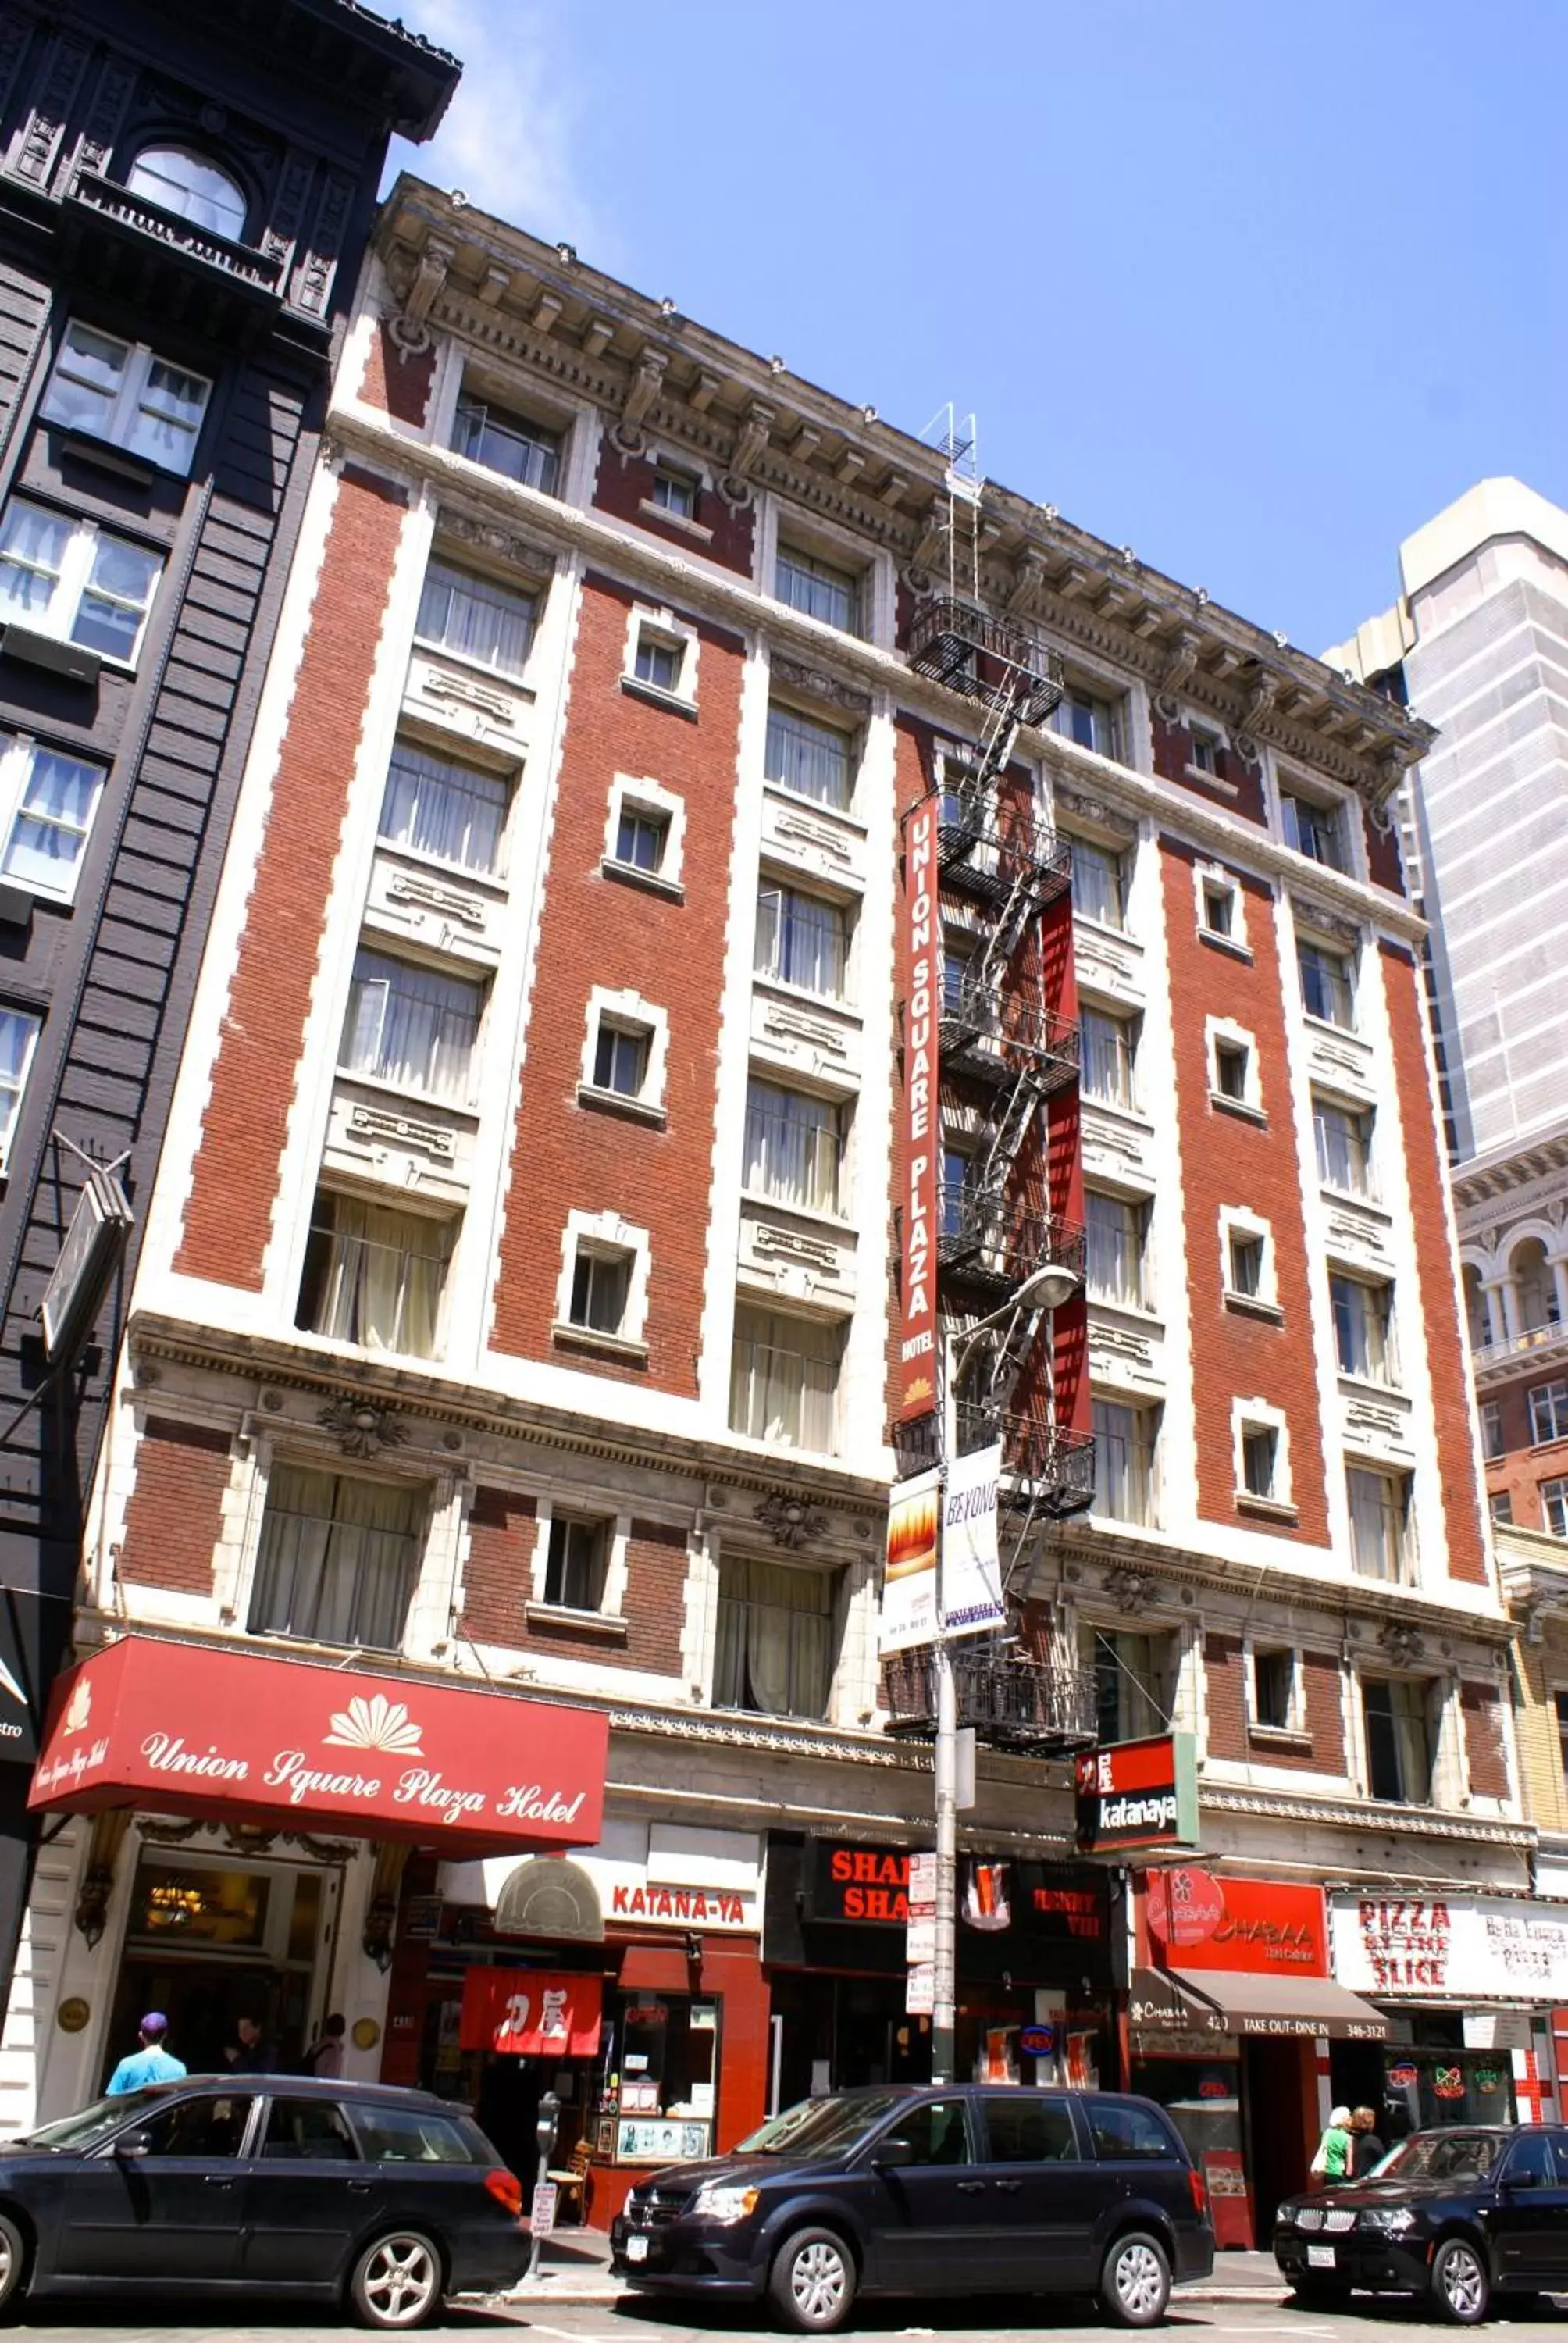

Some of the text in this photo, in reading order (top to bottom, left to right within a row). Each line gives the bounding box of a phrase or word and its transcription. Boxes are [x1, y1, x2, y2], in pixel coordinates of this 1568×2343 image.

[907, 813, 931, 1320] UNION SQUARE PLAZA
[902, 1330, 934, 1362] HOTEL
[141, 1732, 586, 1824] Union Square Plaza Hotel
[1099, 1796, 1177, 1828] katanaya
[613, 1886, 745, 1923] KATANA-YA
[1359, 1900, 1450, 1928] PIZZA
[1364, 1935, 1447, 1951] BY THE
[1373, 1958, 1446, 1985] SLICE
[1243, 2018, 1267, 2032] TAKE
